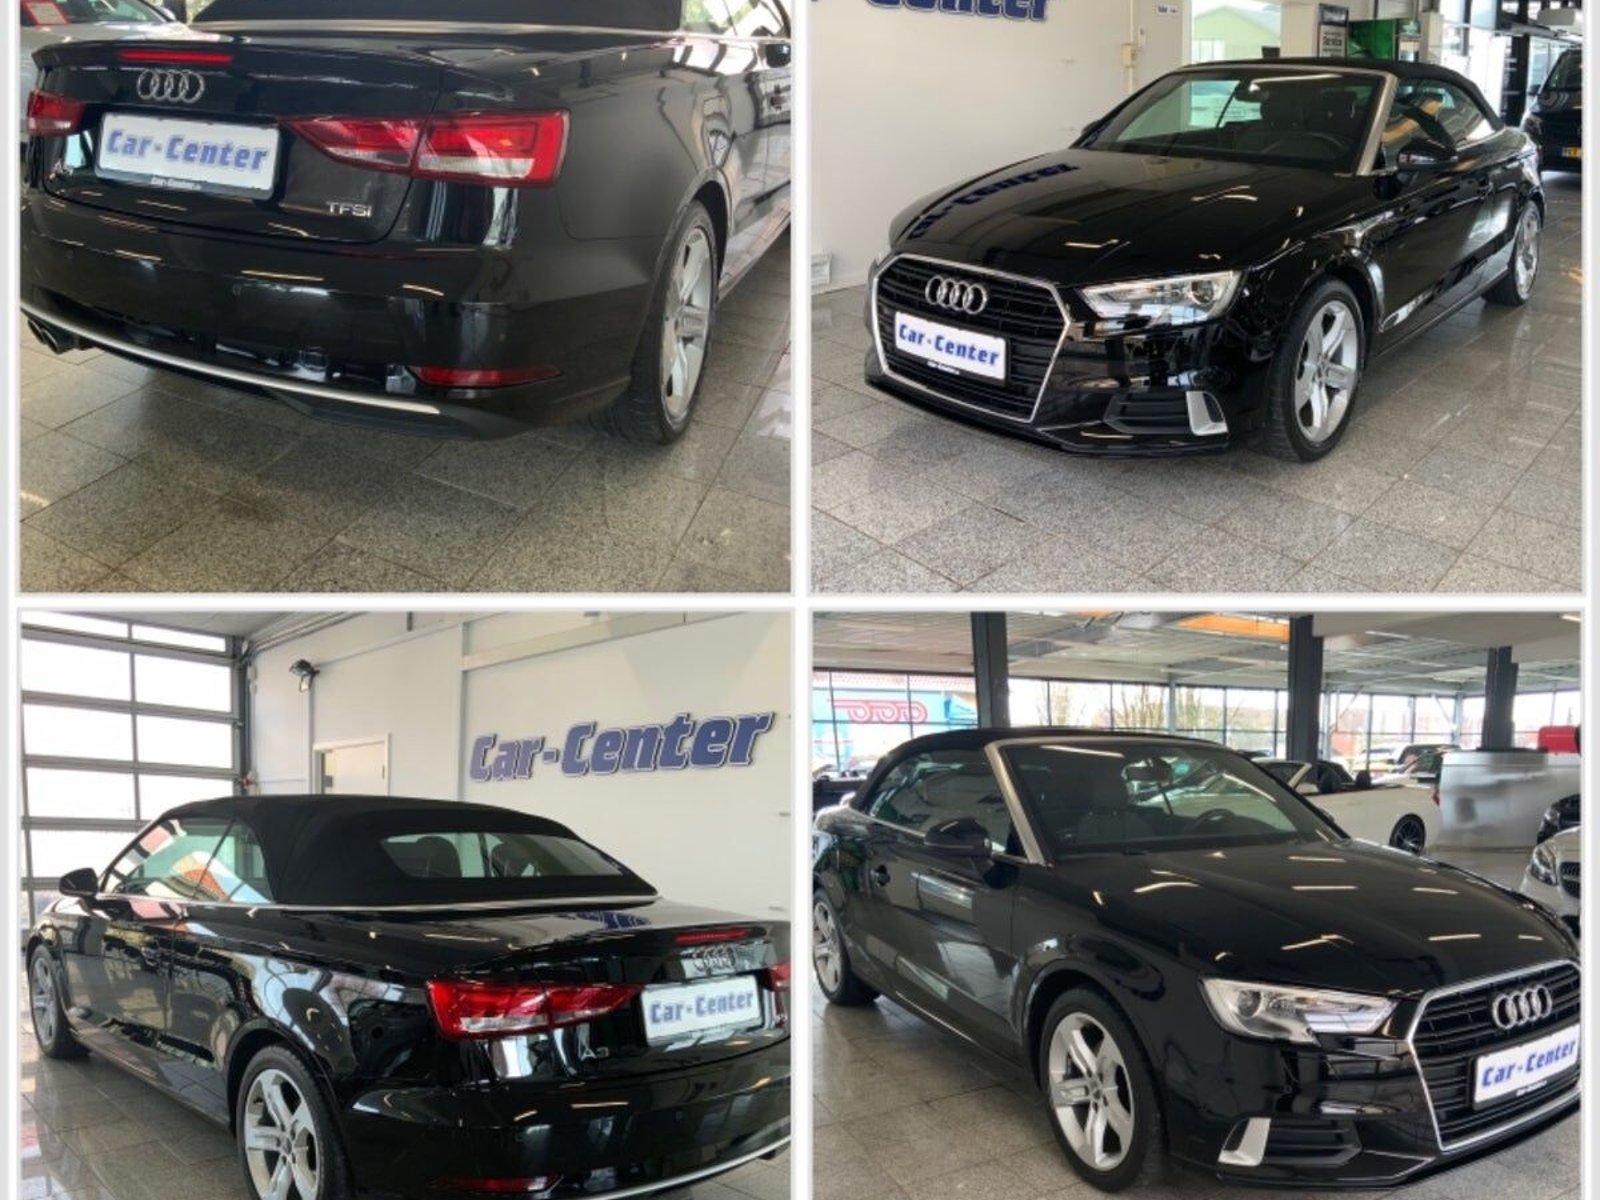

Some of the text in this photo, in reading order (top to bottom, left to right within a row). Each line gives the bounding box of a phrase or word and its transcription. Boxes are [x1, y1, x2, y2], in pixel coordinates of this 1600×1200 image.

[106, 129, 269, 170] Car-Center
[325, 201, 371, 218] TFSI
[899, 323, 999, 366] Car-Center
[469, 711, 776, 784] Car-Center
[650, 990, 754, 1025] Car-Center
[1482, 1040, 1577, 1087] Car-Center
